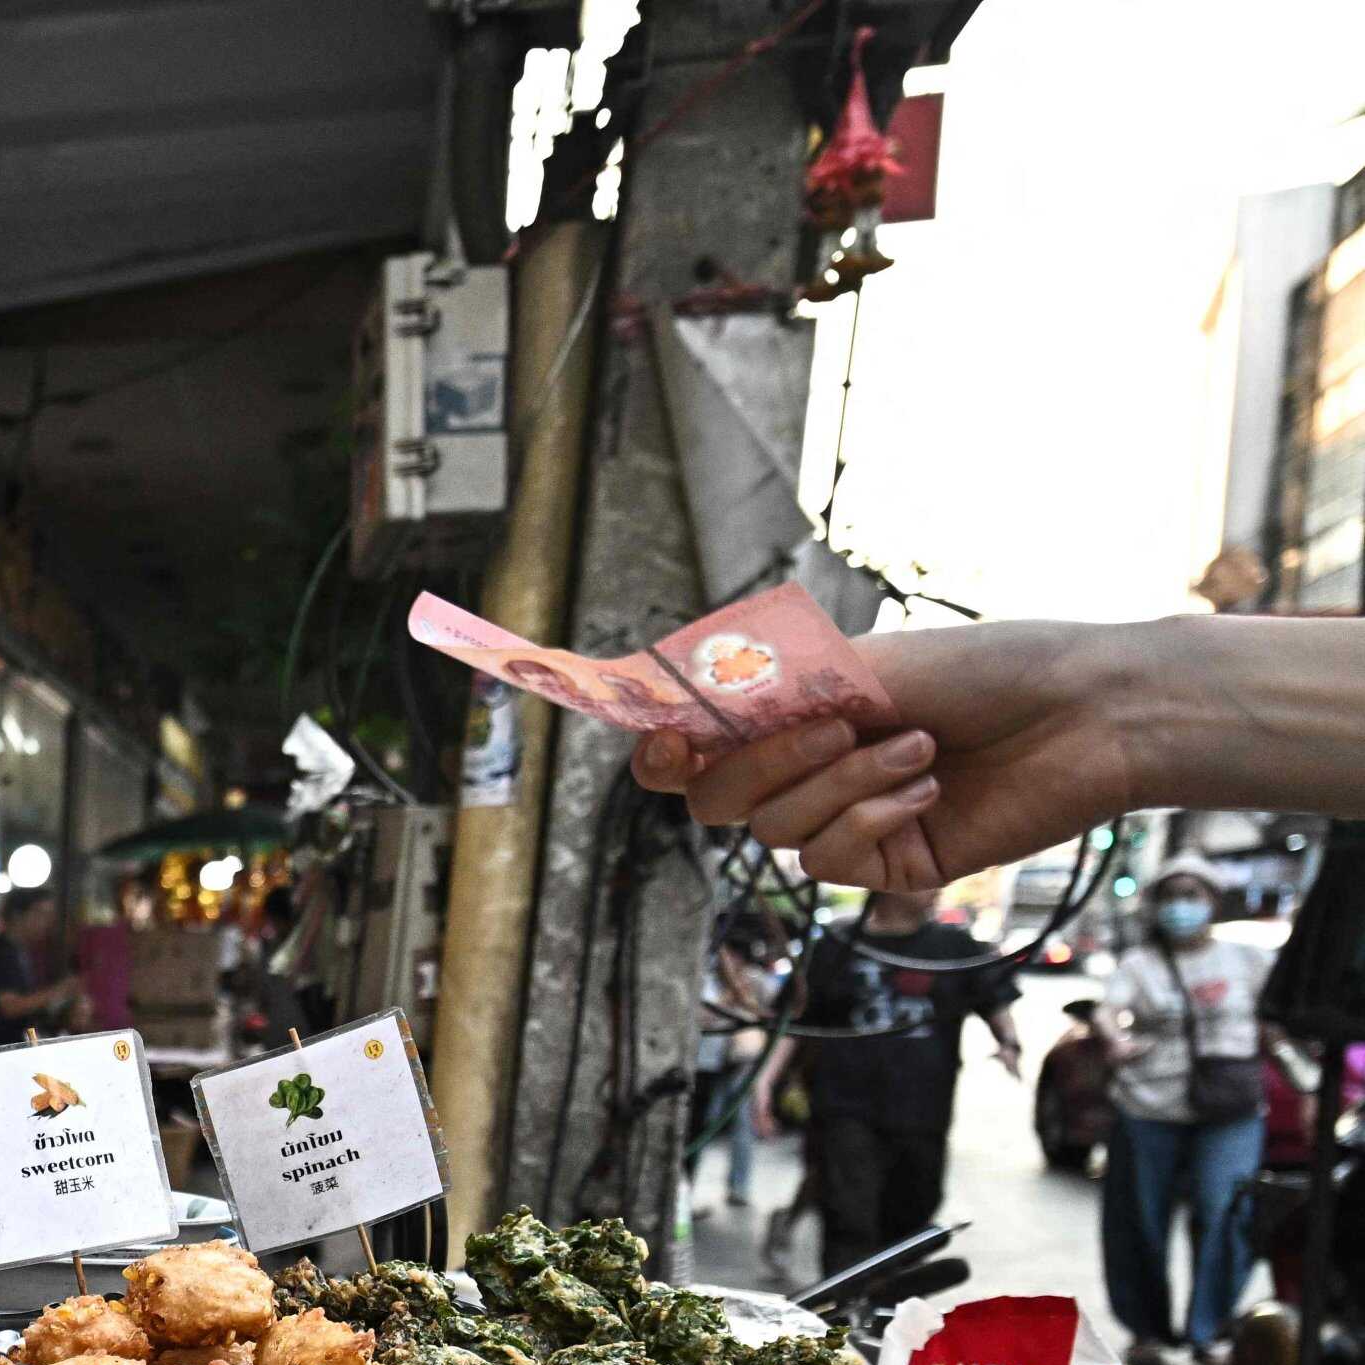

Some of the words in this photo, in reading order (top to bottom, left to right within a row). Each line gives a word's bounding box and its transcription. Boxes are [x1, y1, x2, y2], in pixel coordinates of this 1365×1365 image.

[33, 1128, 95, 1150] ข้าวโพด
[281, 1128, 343, 1158] ผักโขม
[21, 1152, 115, 1178] sweetcorn
[282, 1148, 361, 1183] spinach
[54, 1175, 95, 1196] 甜玉米
[310, 1177, 340, 1196] 菠菜
